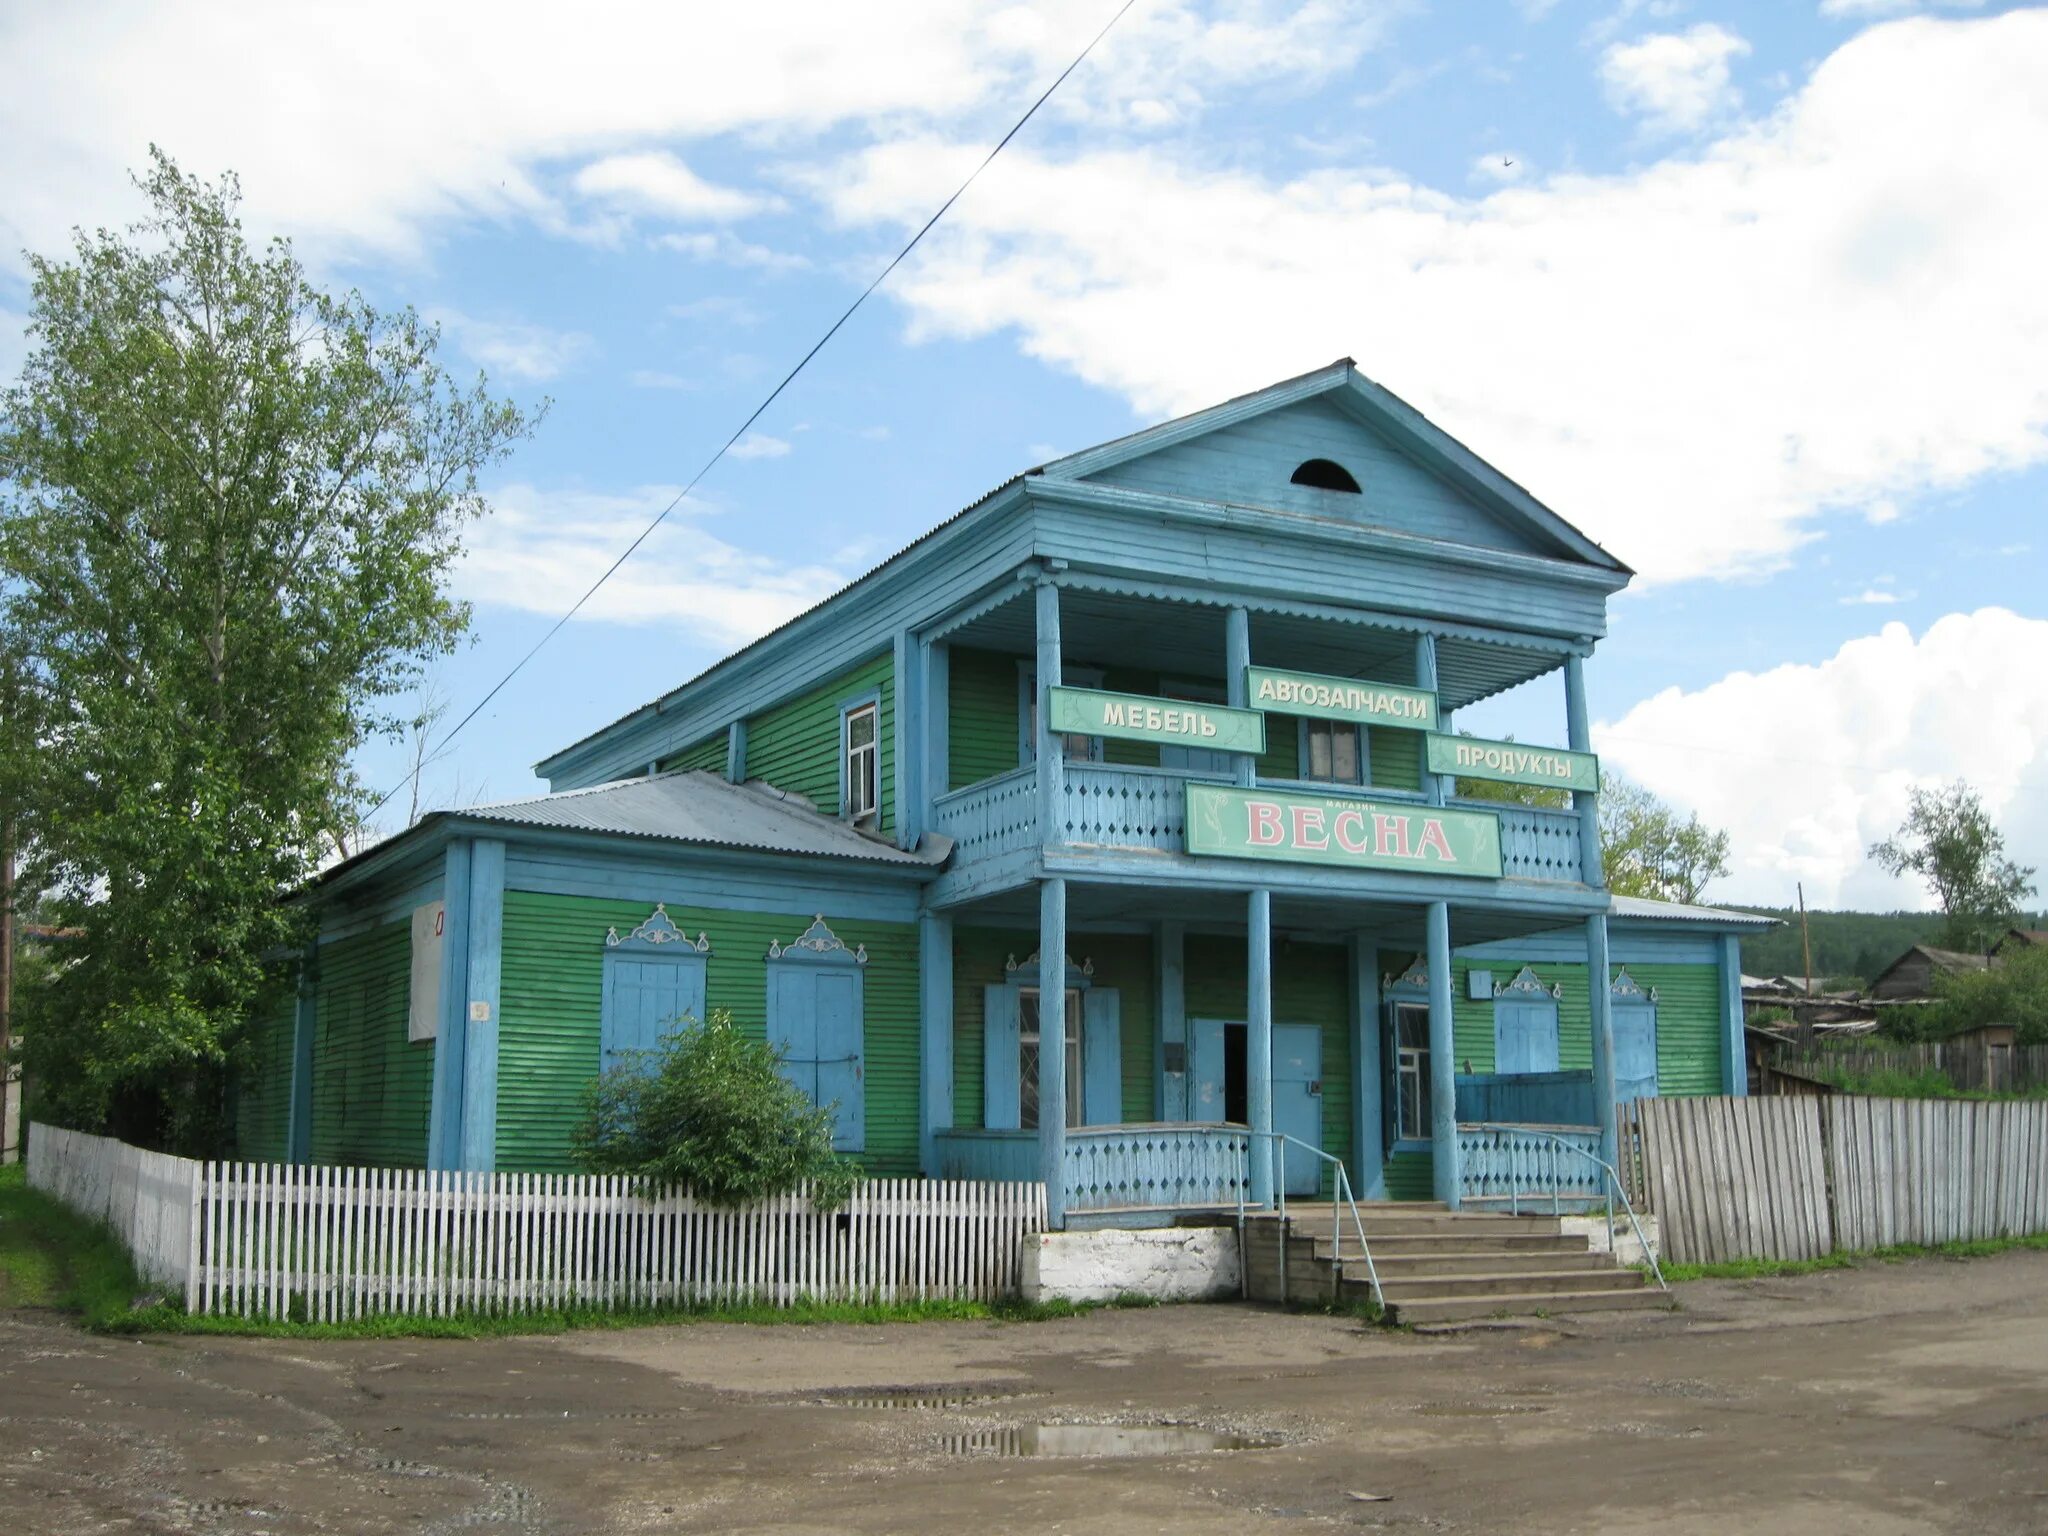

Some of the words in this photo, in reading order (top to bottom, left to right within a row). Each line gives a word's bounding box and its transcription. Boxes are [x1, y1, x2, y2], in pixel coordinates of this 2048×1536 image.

[1259, 678, 1427, 719] АВТОЗАПЧАСТИ
[1103, 703, 1217, 737] МЕБЕЛЬ
[1456, 744, 1572, 778] ПРОДУКТЫ
[1326, 799, 1376, 812] МАГАЗИН
[1245, 801, 1457, 861] ВЕСНА
